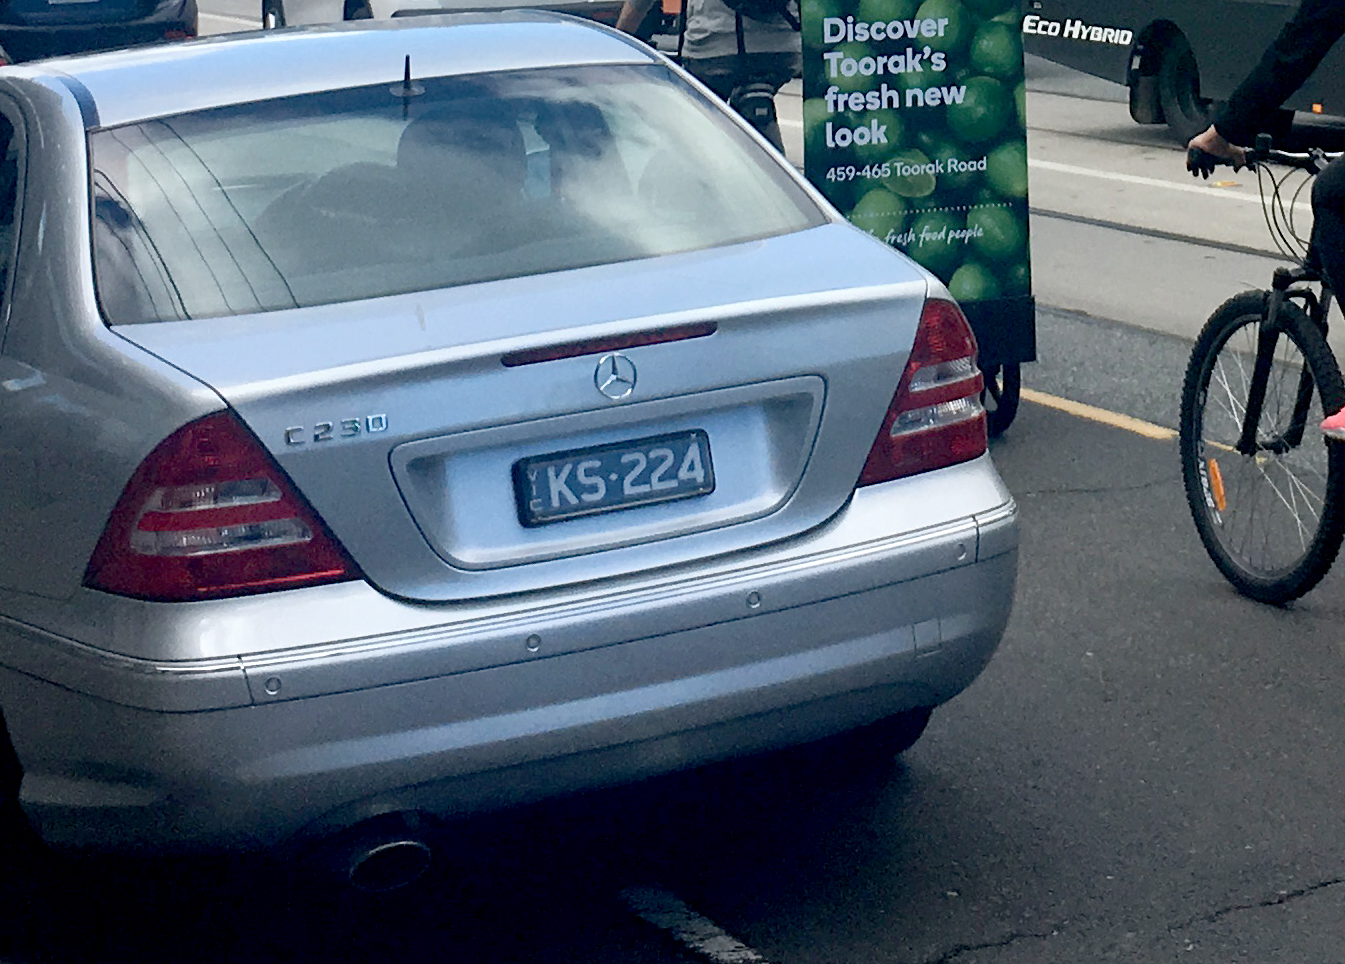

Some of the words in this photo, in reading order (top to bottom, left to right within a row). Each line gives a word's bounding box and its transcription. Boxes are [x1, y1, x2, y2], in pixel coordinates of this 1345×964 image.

[823, 16, 949, 43] Discover
[823, 46, 947, 78] Toorak's
[825, 84, 899, 113] fresh
[905, 85, 966, 107] new
[825, 119, 889, 147] look
[825, 162, 891, 182] 459-465
[895, 160, 944, 177] Toorak
[947, 157, 987, 173] Road
[884, 228, 916, 246] fresh
[919, 225, 947, 247] food
[947, 224, 984, 244] people
